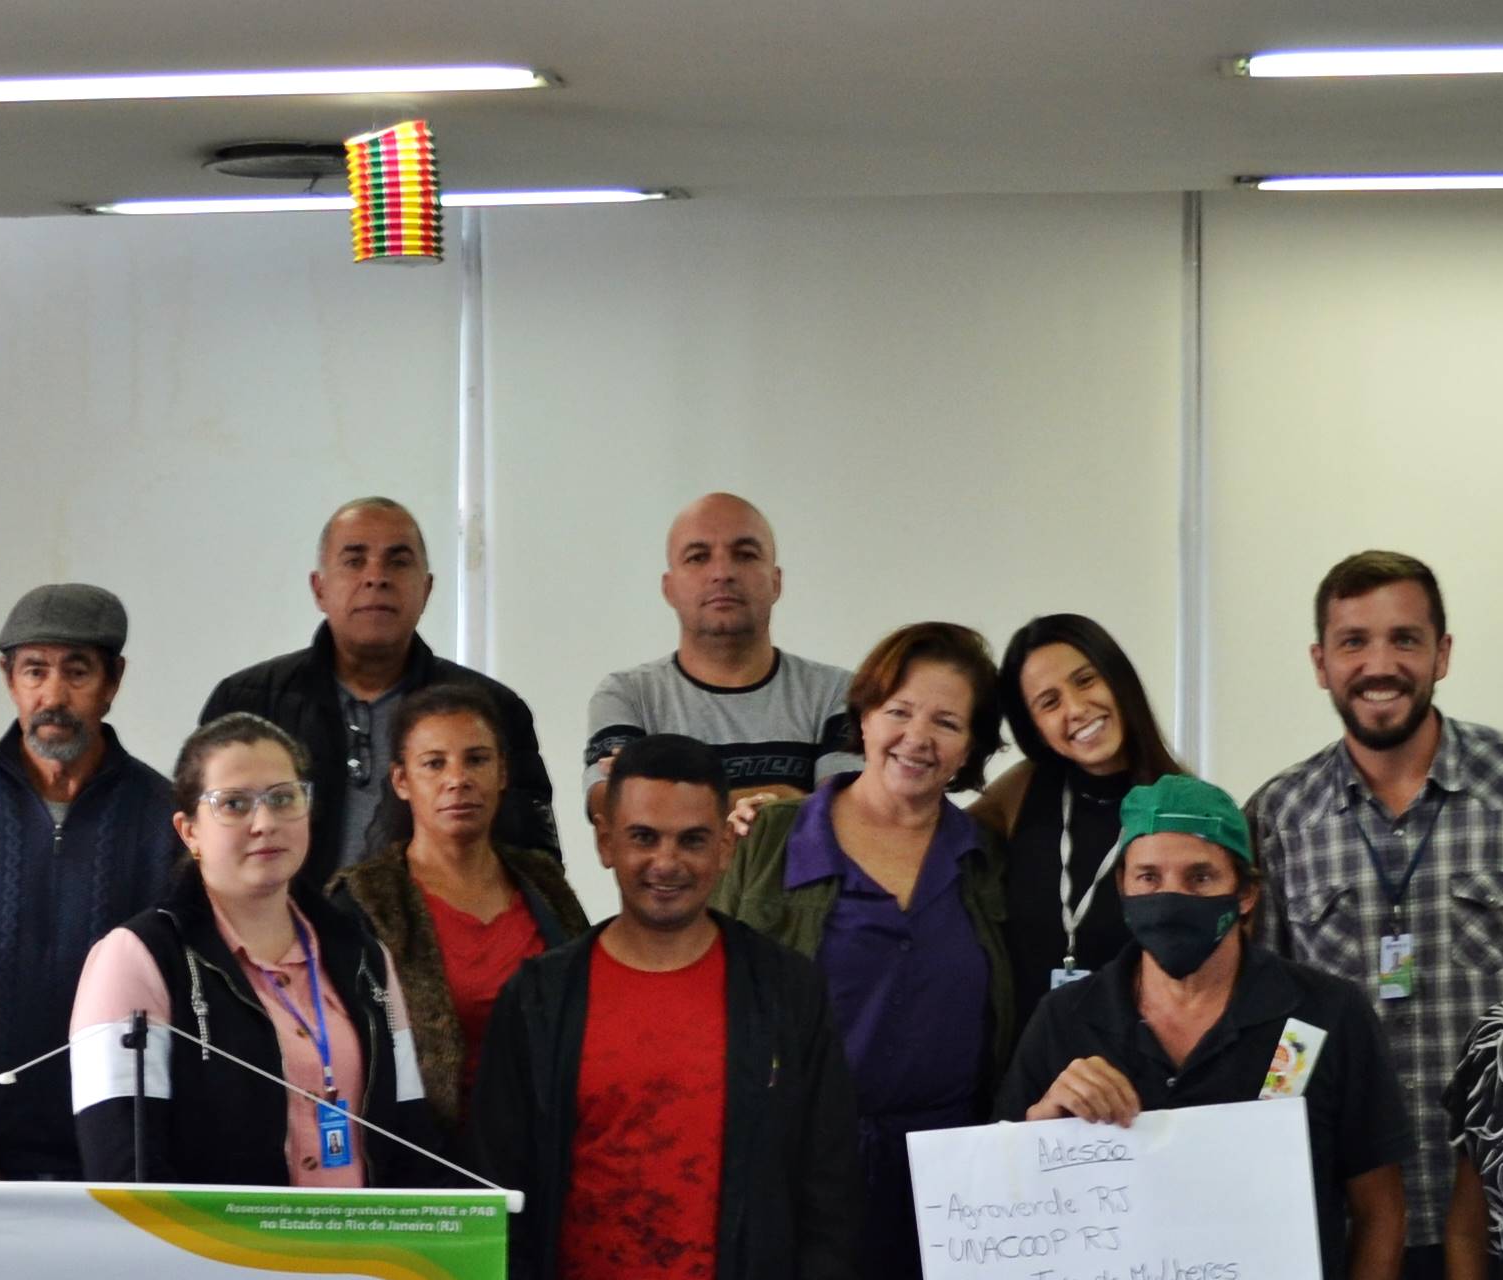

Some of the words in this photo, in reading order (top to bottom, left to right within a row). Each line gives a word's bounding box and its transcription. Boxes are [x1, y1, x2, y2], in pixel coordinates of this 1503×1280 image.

[1038, 1138, 1129, 1165] Adesão
[1087, 1185, 1131, 1213] RJ
[279, 1219, 322, 1230] Estado
[345, 1219, 365, 1231] Rio
[368, 1220, 385, 1231] de
[387, 1220, 434, 1232] Janeiro
[1076, 1226, 1121, 1251] RJ
